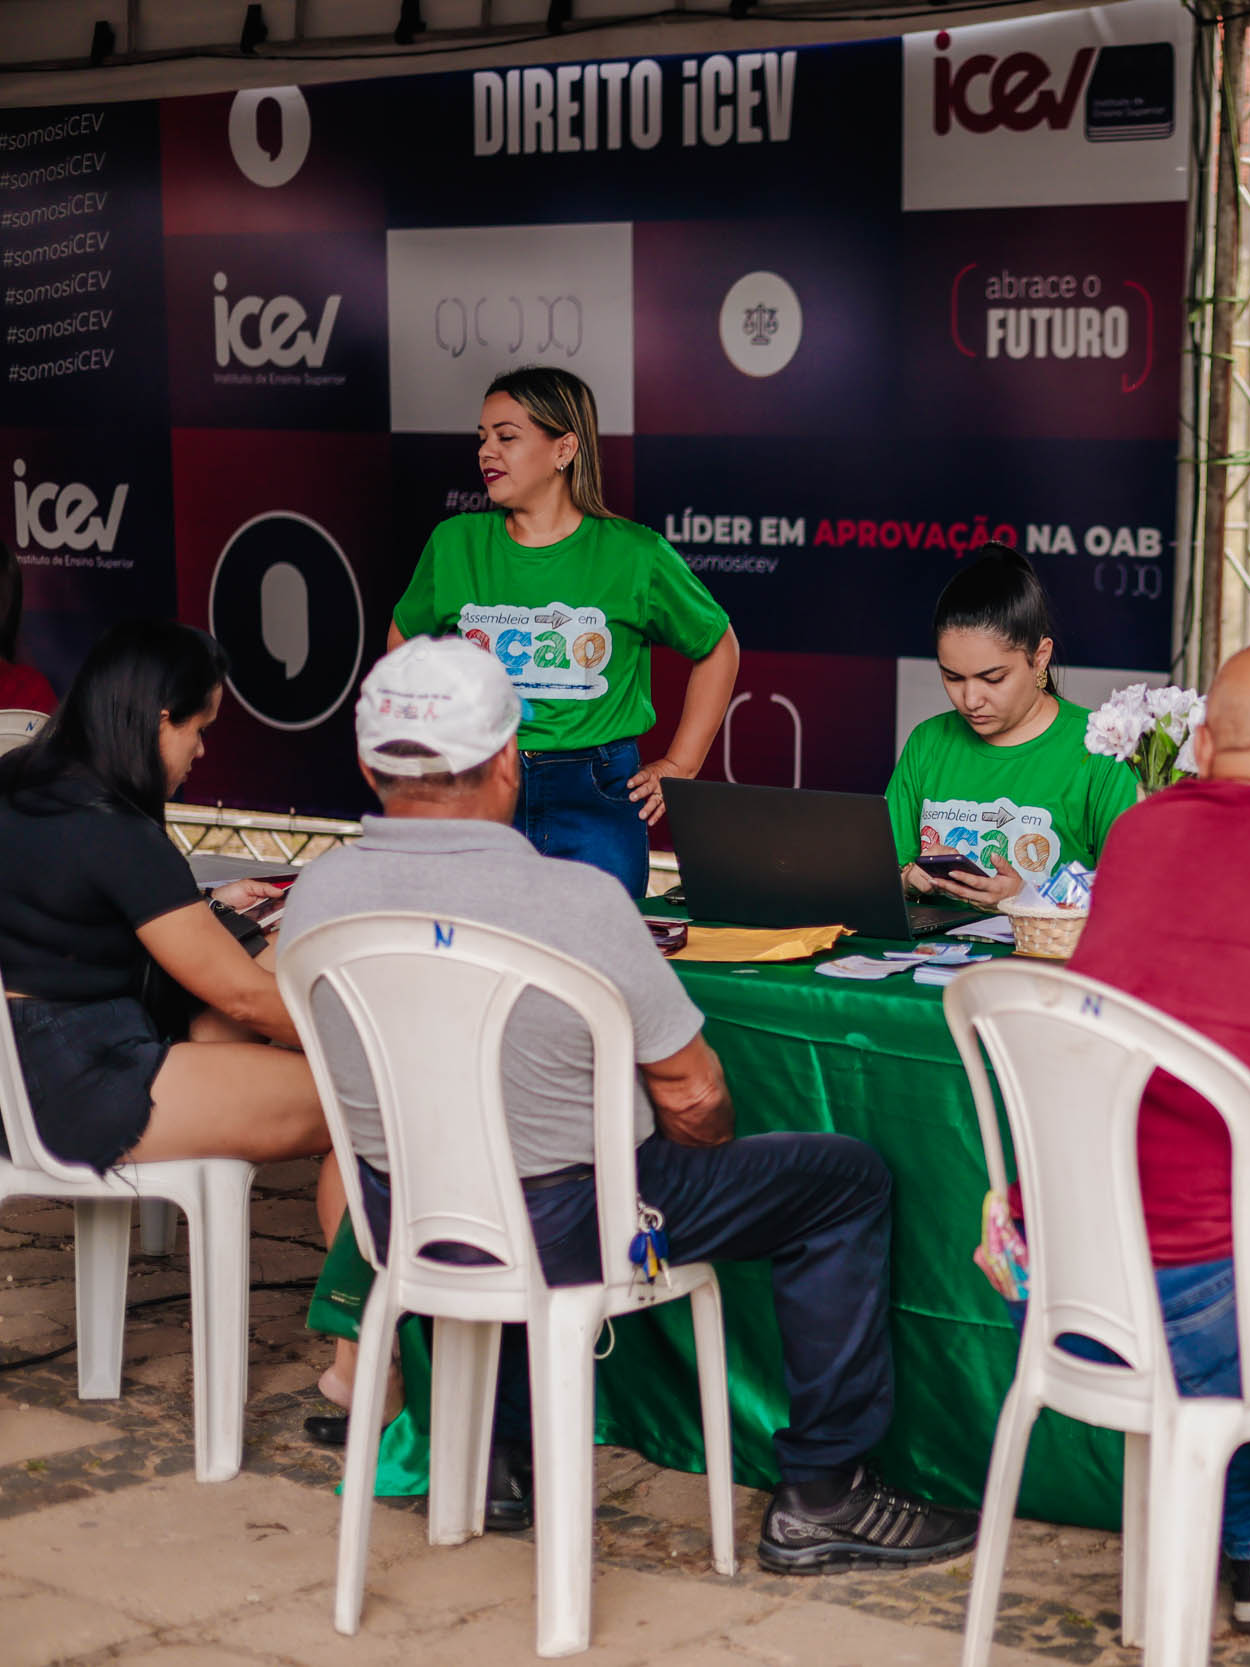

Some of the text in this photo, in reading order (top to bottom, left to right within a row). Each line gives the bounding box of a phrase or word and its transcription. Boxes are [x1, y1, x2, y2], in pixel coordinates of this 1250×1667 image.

[473, 51, 798, 157] DIREITO iCEV
[0, 112, 104, 150] #somosiCEV
[0, 152, 106, 189] #somosiCEV
[1, 192, 108, 228] #somosiCEV
[3, 231, 110, 267] #somosiCEV
[5, 270, 111, 306] #somosiCEV
[985, 271, 1100, 299] abrace o
[7, 309, 112, 344] #somosiCEV
[987, 305, 1128, 360] FUTURO
[8, 349, 114, 382] #somosiCEV
[665, 507, 1162, 558] LÍDER EM APROVAÇÃO NA OAB
[686, 554, 779, 574] somosicev
[463, 611, 598, 625] Assembleia em
[1021, 814, 1042, 826] em
